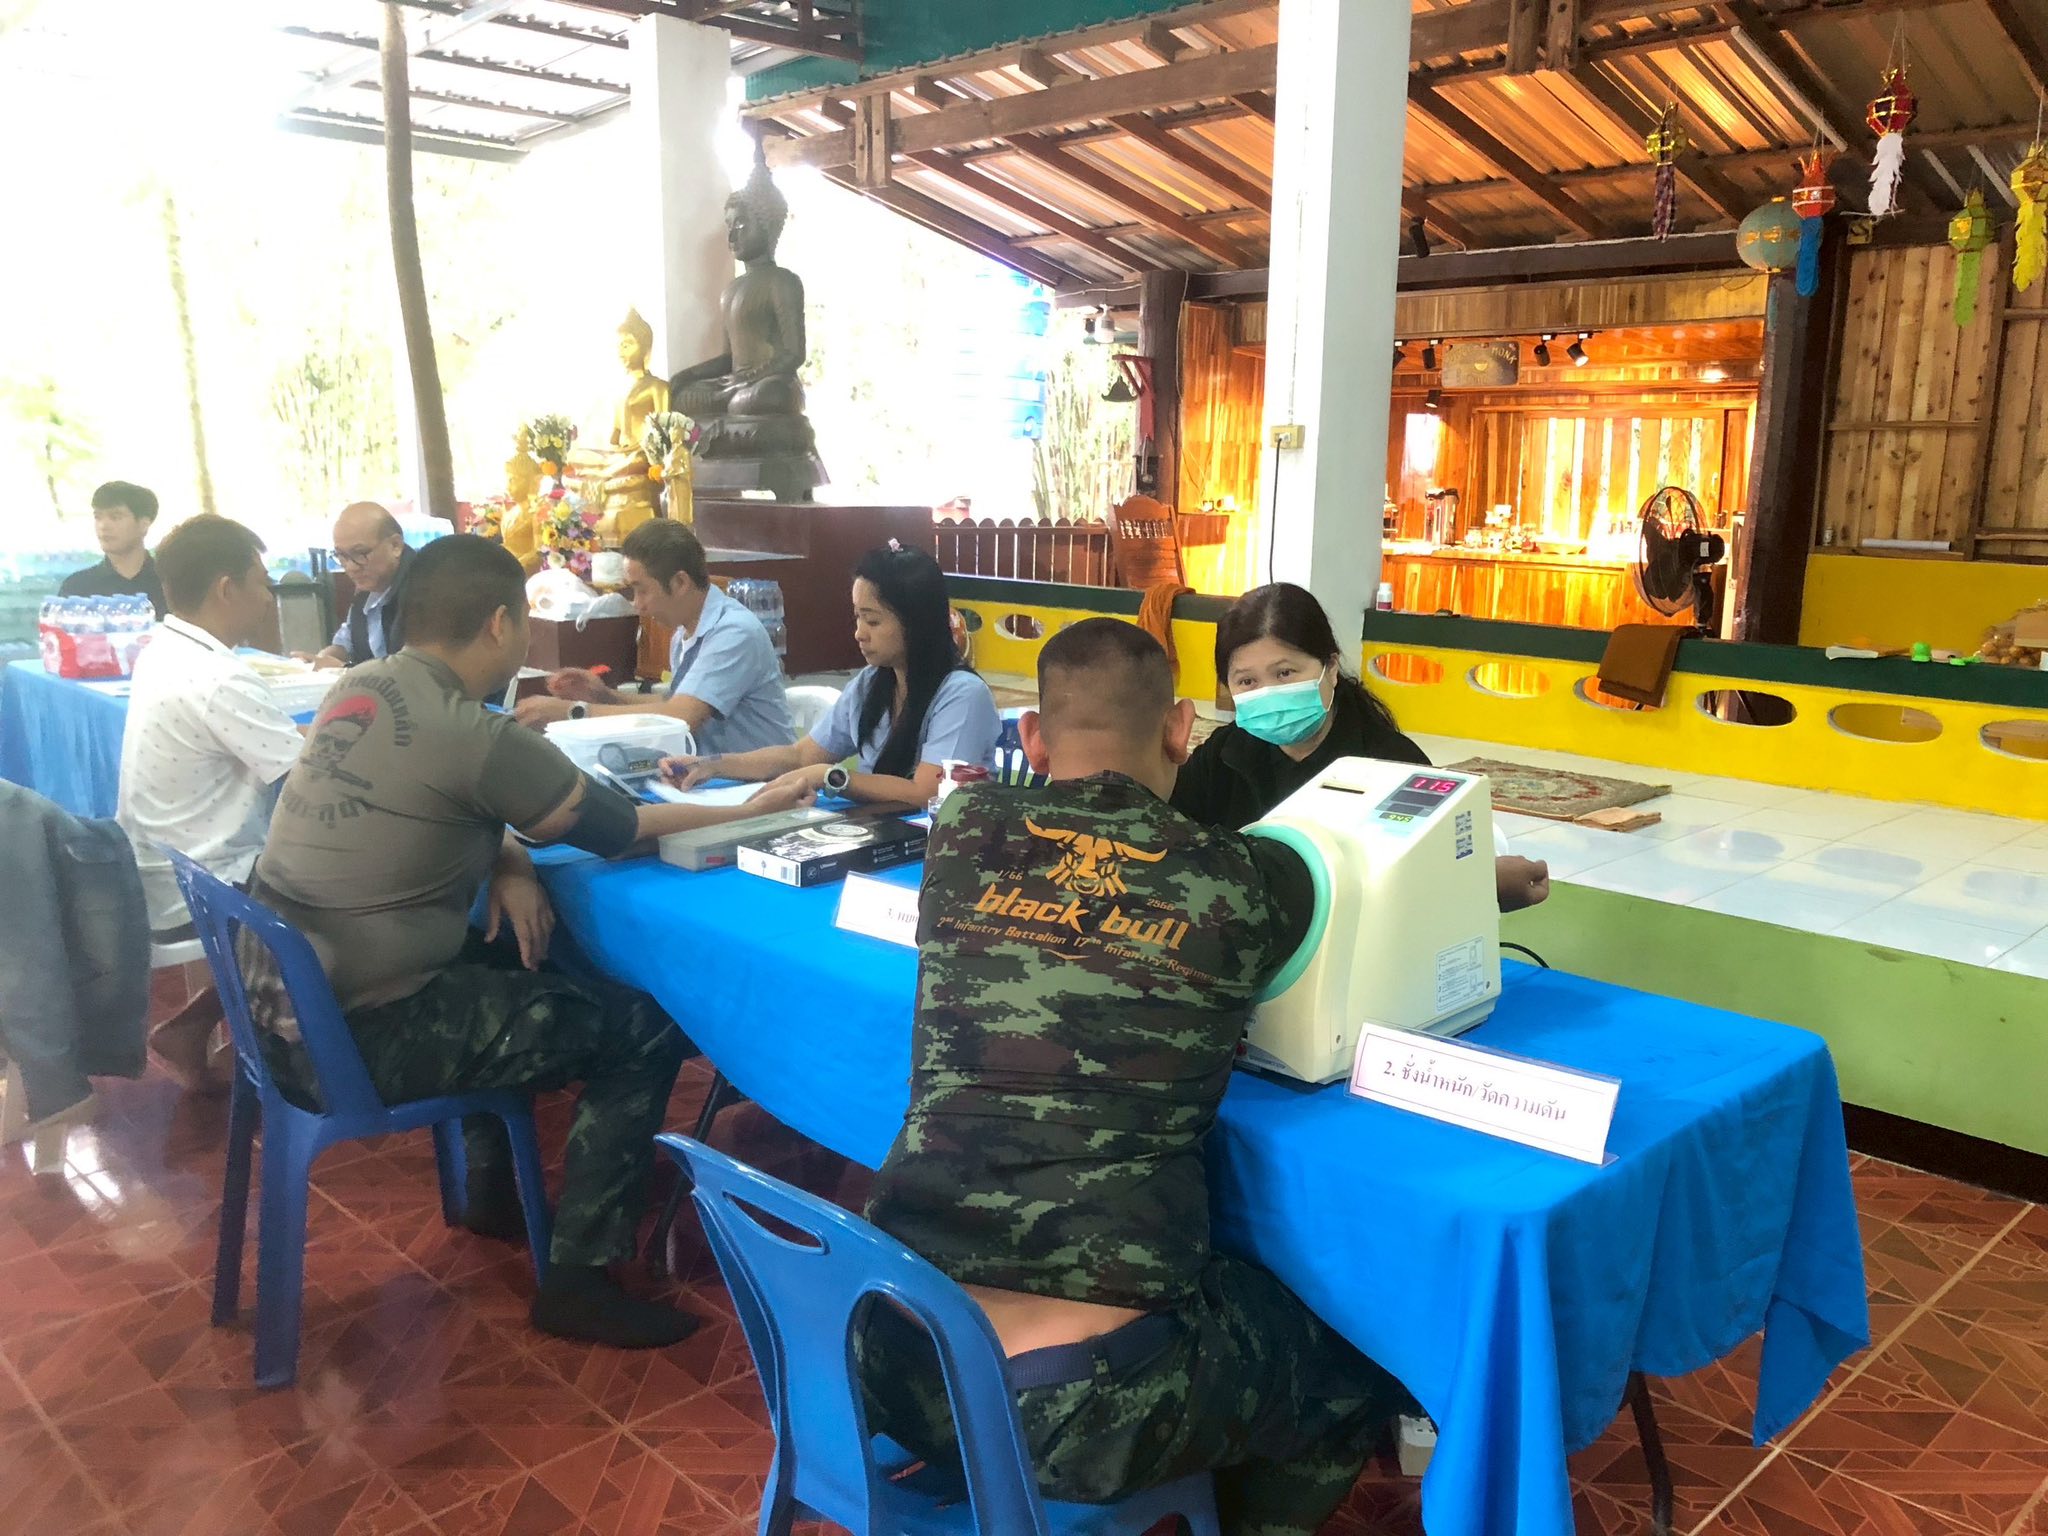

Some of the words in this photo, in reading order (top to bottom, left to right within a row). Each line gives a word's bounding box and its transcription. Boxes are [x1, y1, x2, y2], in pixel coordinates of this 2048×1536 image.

[1413, 778, 1455, 792] 115
[974, 882, 1090, 934] black
[1099, 904, 1190, 951] bull
[954, 918, 1002, 936] Infantry
[1004, 925, 1067, 945] Battalion
[1383, 1060, 1397, 1077] 2.
